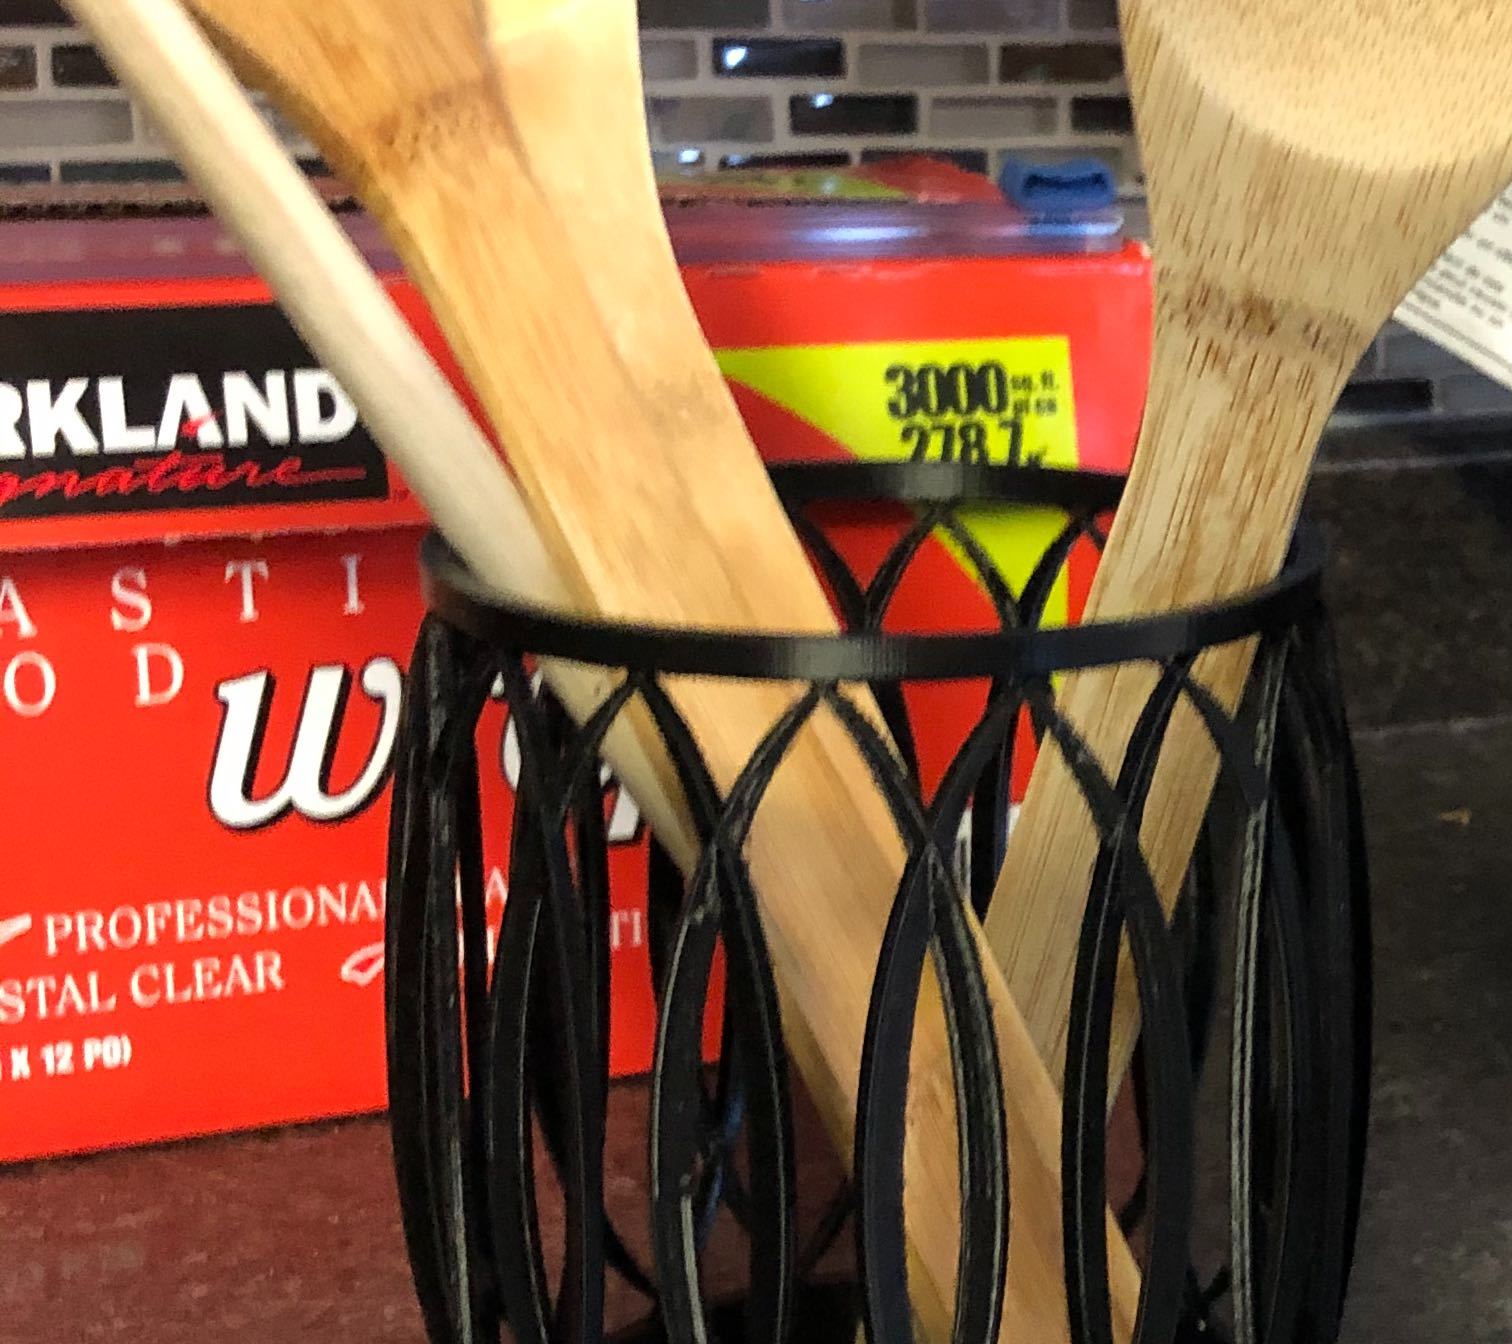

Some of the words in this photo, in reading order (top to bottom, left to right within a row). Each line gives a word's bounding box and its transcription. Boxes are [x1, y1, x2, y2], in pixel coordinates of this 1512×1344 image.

[884, 359, 1008, 421] 3000
[129, 949, 284, 1008] CLEAR
[41, 1040, 74, 1077] 12
